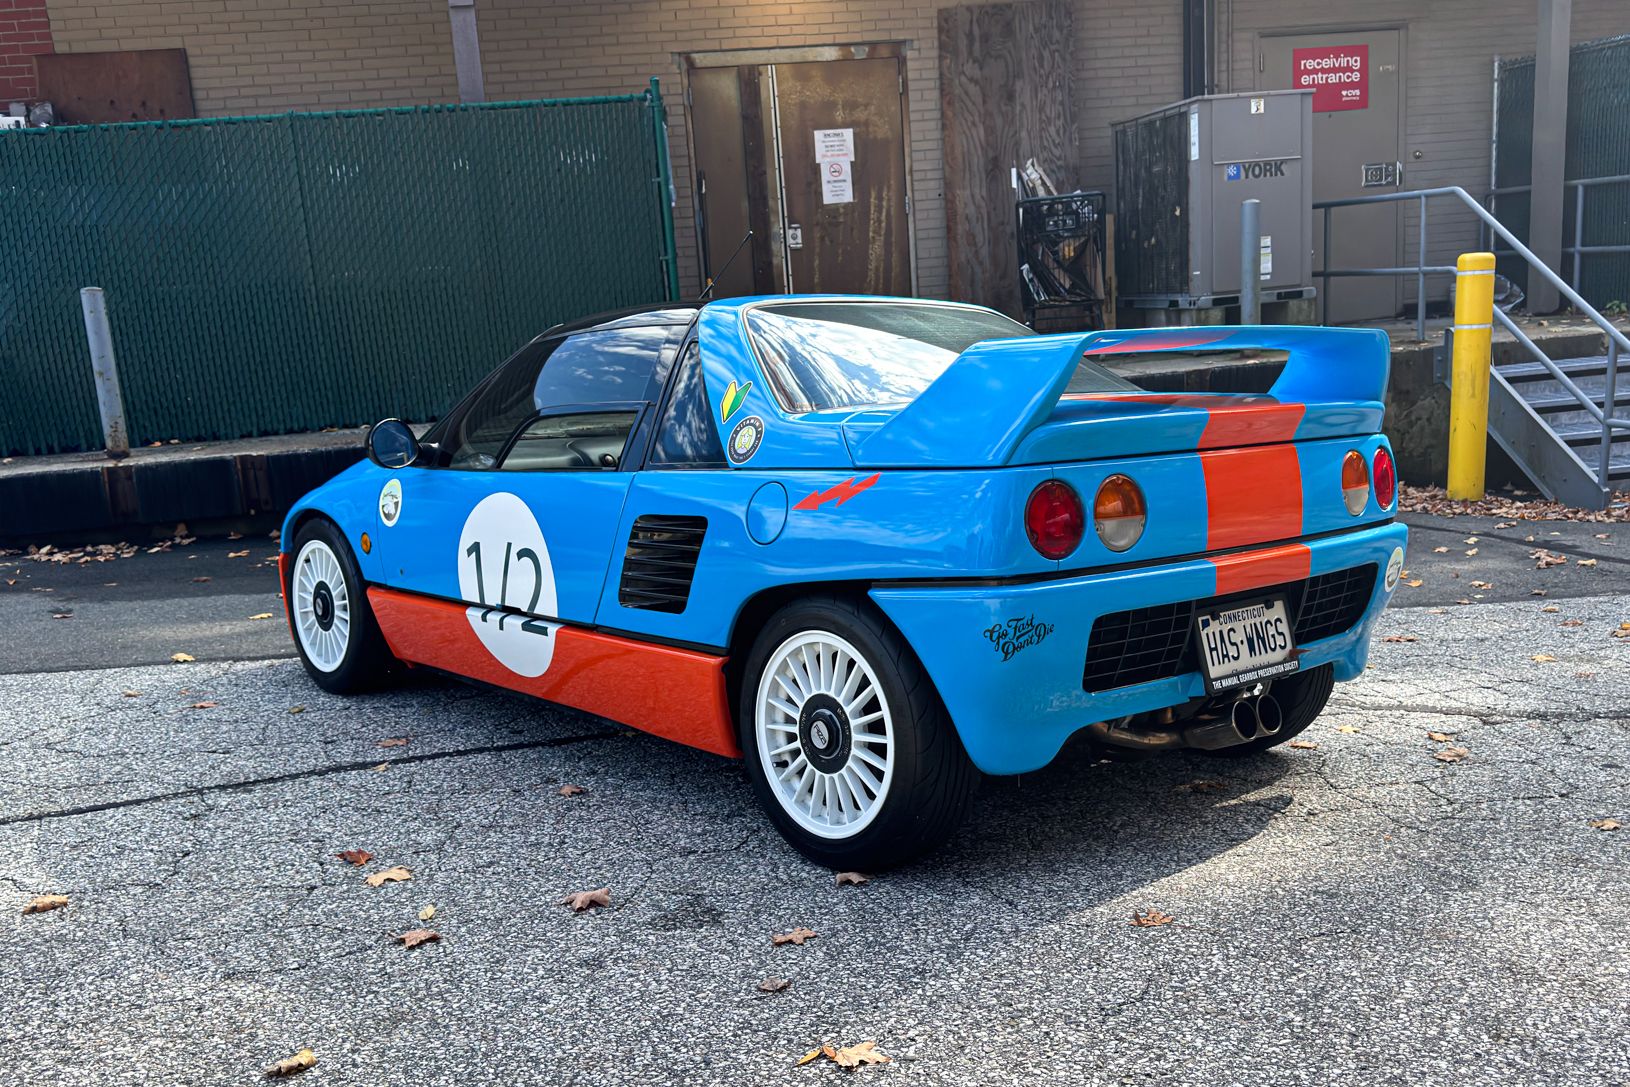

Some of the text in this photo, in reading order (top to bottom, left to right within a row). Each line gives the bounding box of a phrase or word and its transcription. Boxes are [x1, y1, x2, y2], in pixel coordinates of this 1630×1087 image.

[1300, 53, 1361, 70] receiving
[1300, 71, 1361, 85] entrance
[1241, 161, 1285, 179] YORK
[466, 541, 549, 636] 1/2
[1219, 606, 1265, 626] CONNECTICUT
[983, 613, 1035, 652] Go Fast
[1034, 622, 1055, 646] Die
[1212, 680, 1222, 690] THE
[1222, 675, 1240, 688] MANUAL
[1239, 671, 1258, 684] GEARBOX
[1258, 664, 1284, 679] PRESERVATION
[1283, 660, 1299, 672] SOCIETY
